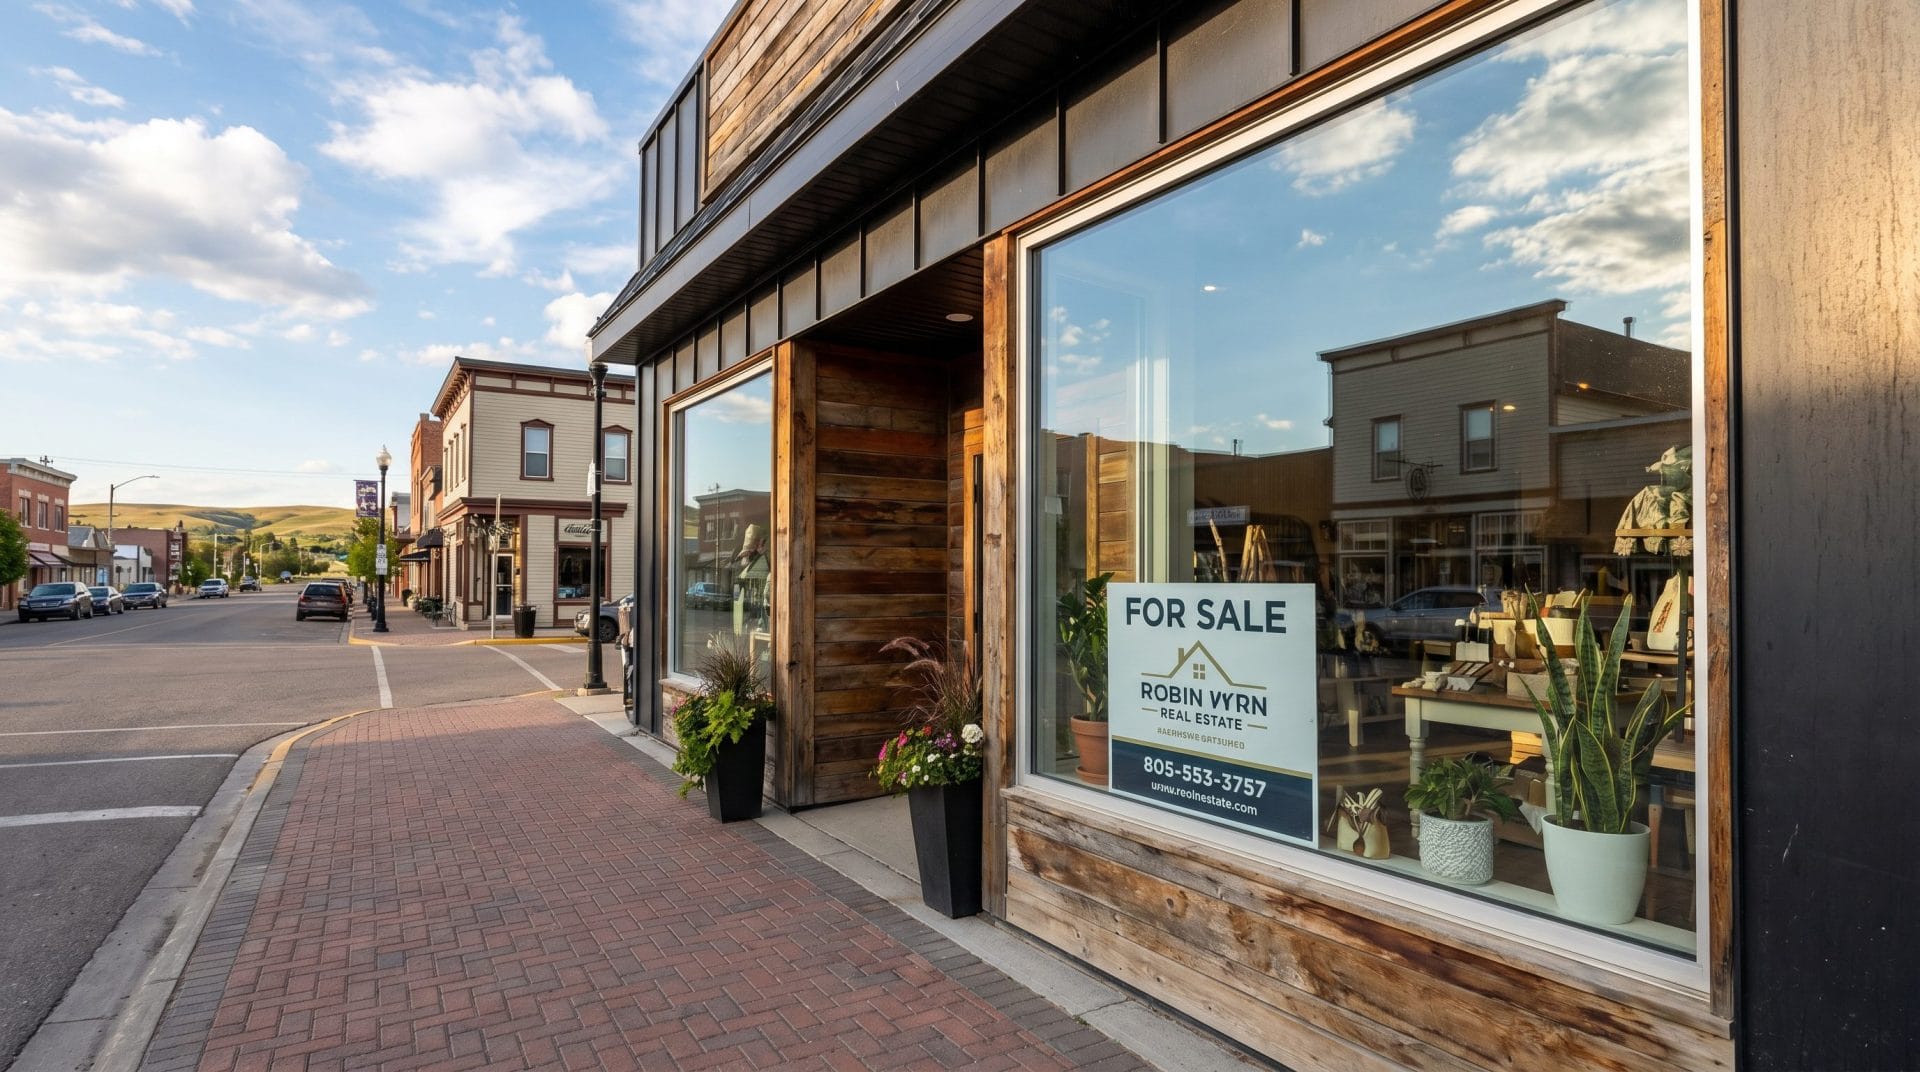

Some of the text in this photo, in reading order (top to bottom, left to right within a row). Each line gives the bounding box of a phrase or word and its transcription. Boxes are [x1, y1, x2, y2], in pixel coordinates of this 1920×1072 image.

[1126, 597, 1287, 634] FOR SALE
[1141, 682, 1203, 707] ROBIN
[1160, 707, 1243, 731] REAL ESTATE
[1143, 756, 1267, 799] 805-553-3757
